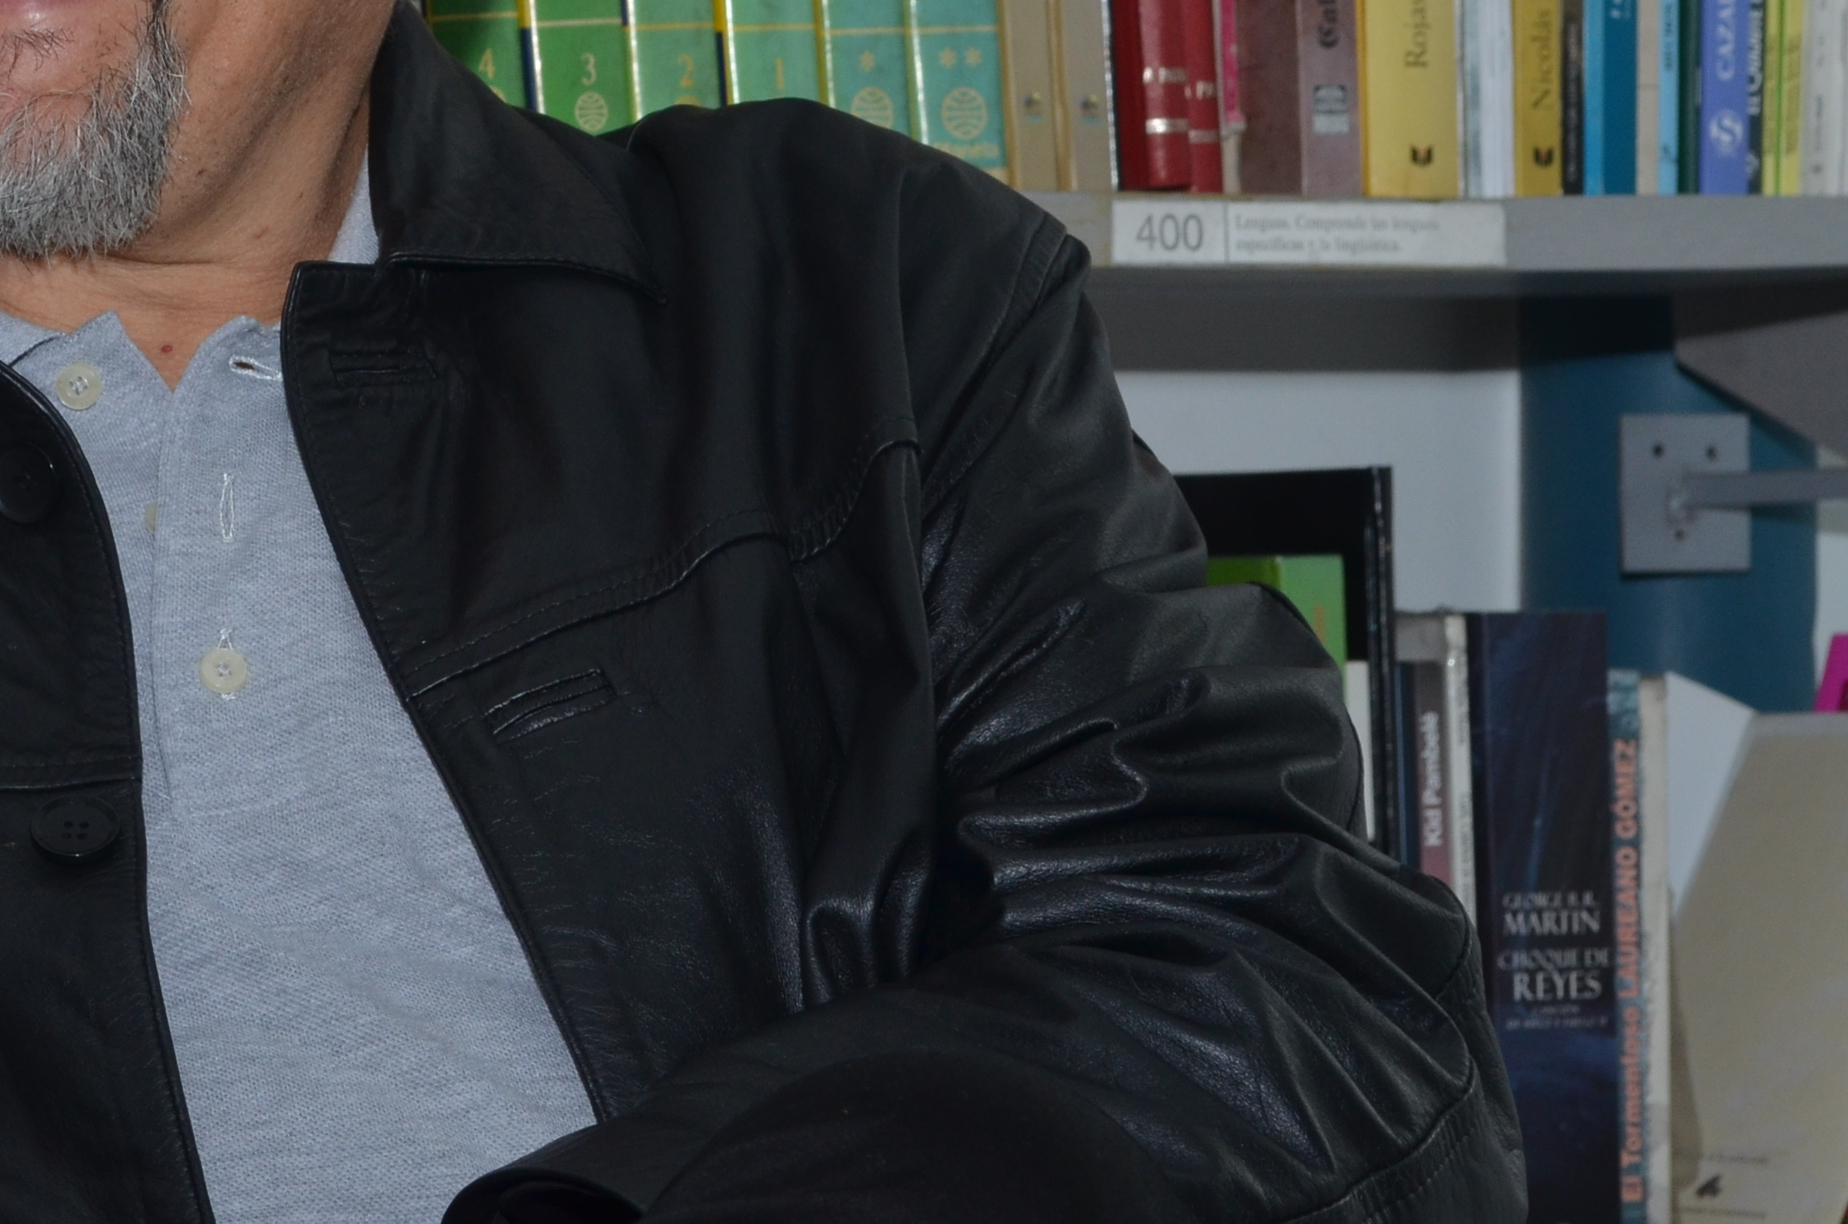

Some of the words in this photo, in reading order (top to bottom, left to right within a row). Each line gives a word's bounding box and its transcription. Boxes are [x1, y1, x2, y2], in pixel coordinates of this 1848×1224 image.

[477, 49, 496, 80] 4
[581, 51, 597, 85] 3
[677, 54, 694, 87] 2
[1136, 213, 1204, 252] 400
[1418, 711, 1443, 804] Pambelé
[1607, 738, 1639, 839] GÓMEZ
[1422, 808, 1444, 847] Kid
[1503, 909, 1600, 936] MARTIN
[1613, 851, 1641, 1000] LAUREANO
[1496, 947, 1578, 972] CHOQUE
[1584, 947, 1610, 967] DE
[1512, 970, 1603, 1002] REYES
[1618, 1007, 1644, 1166] Tormentoso
[1620, 1175, 1644, 1202] El
